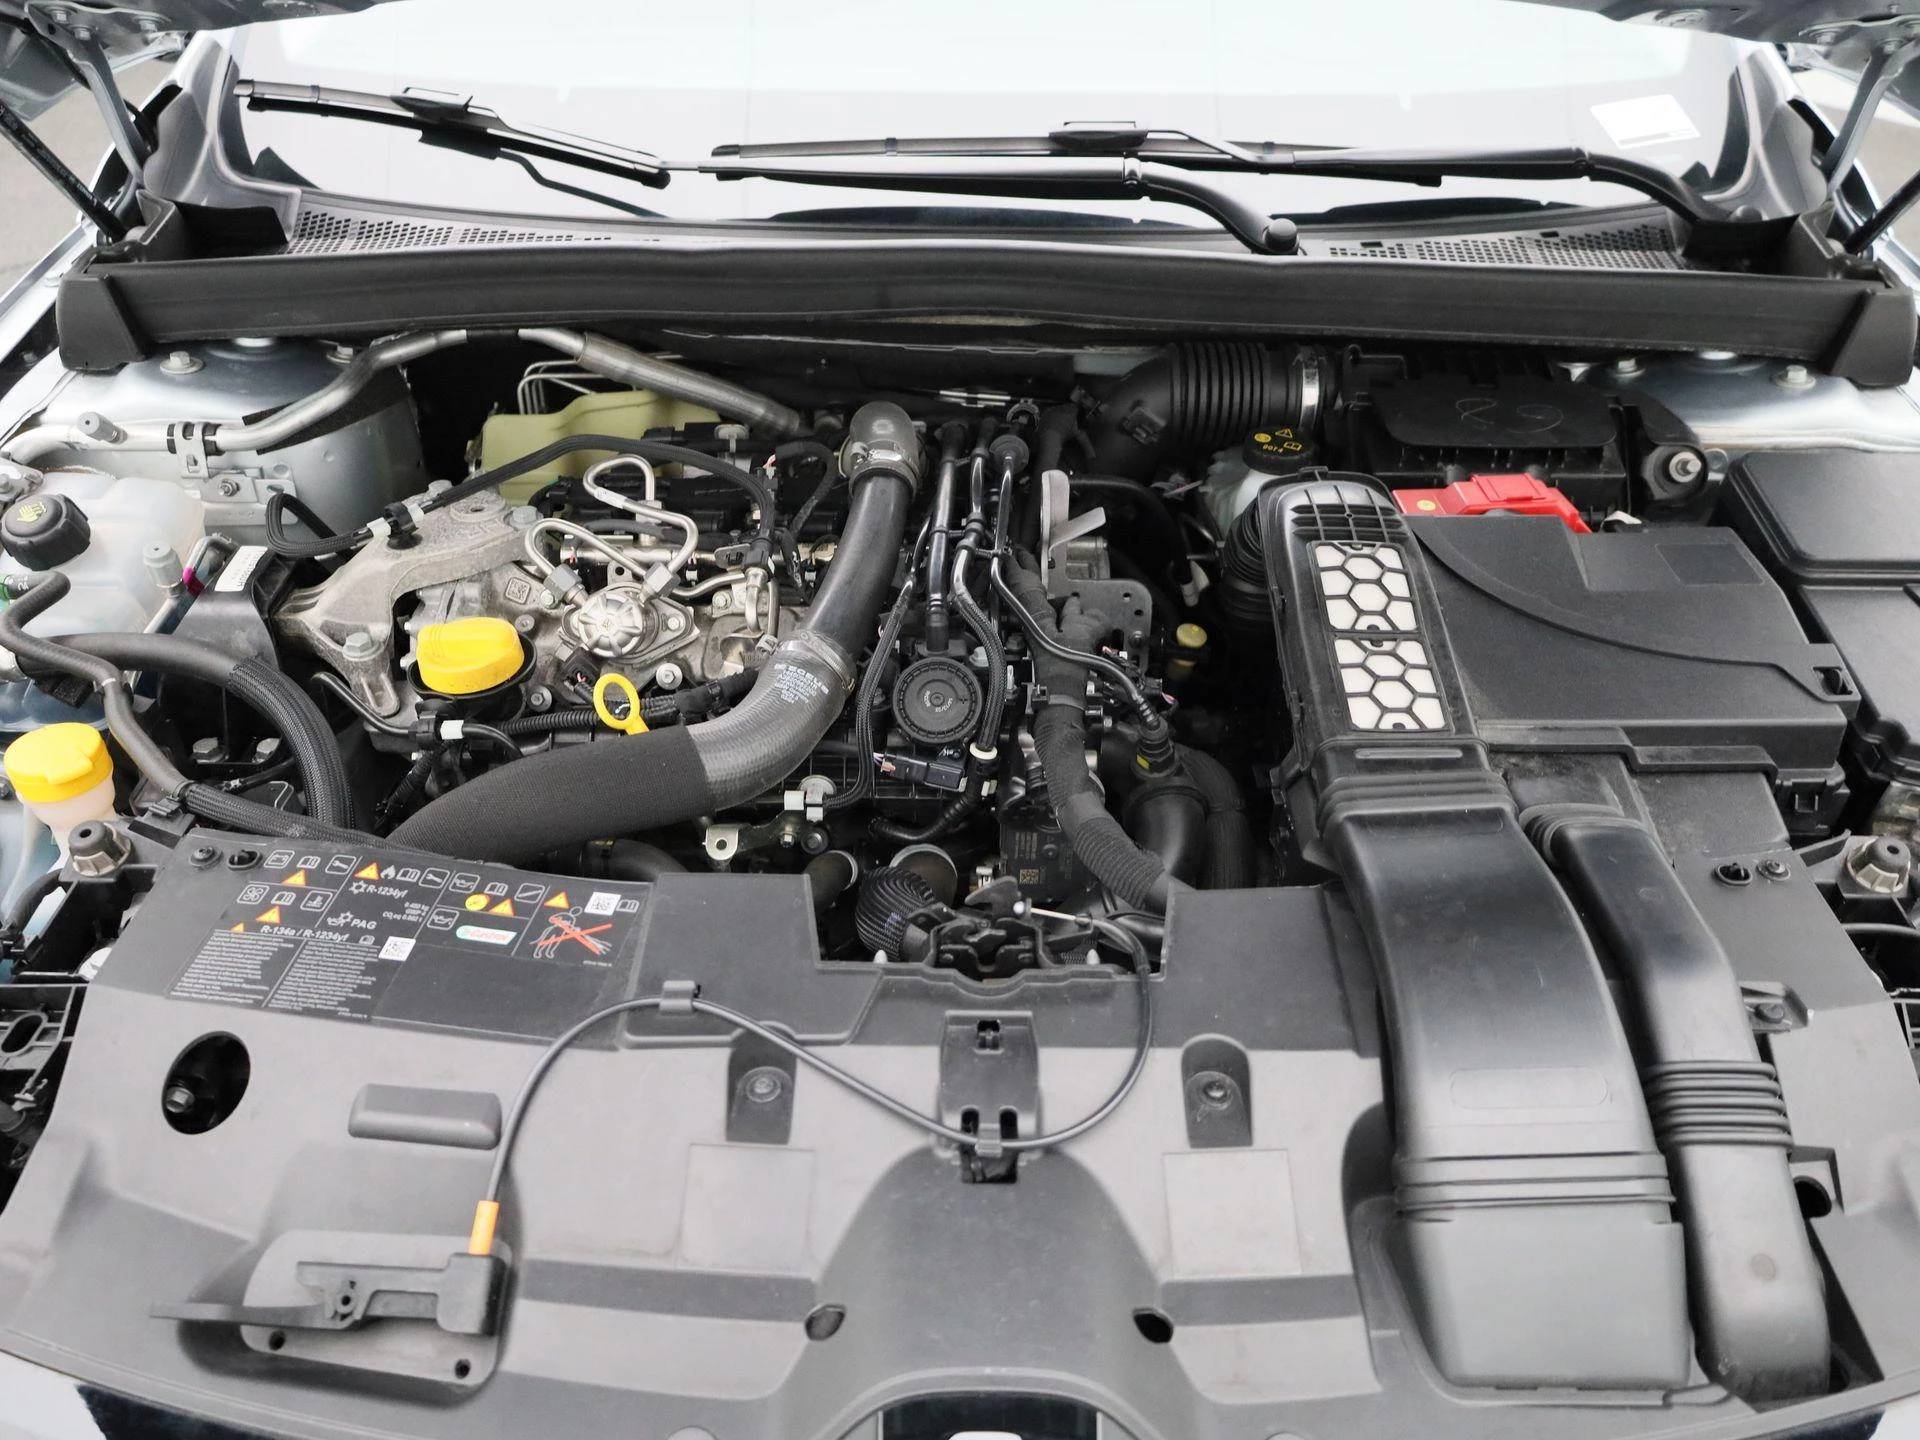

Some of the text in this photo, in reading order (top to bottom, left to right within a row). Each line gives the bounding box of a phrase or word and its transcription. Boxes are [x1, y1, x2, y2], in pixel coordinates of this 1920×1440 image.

[366, 885, 408, 899] R-1234yf
[351, 918, 377, 930] PAG
[260, 925, 296, 936] R-134a
[302, 928, 350, 943] R-1234yf
